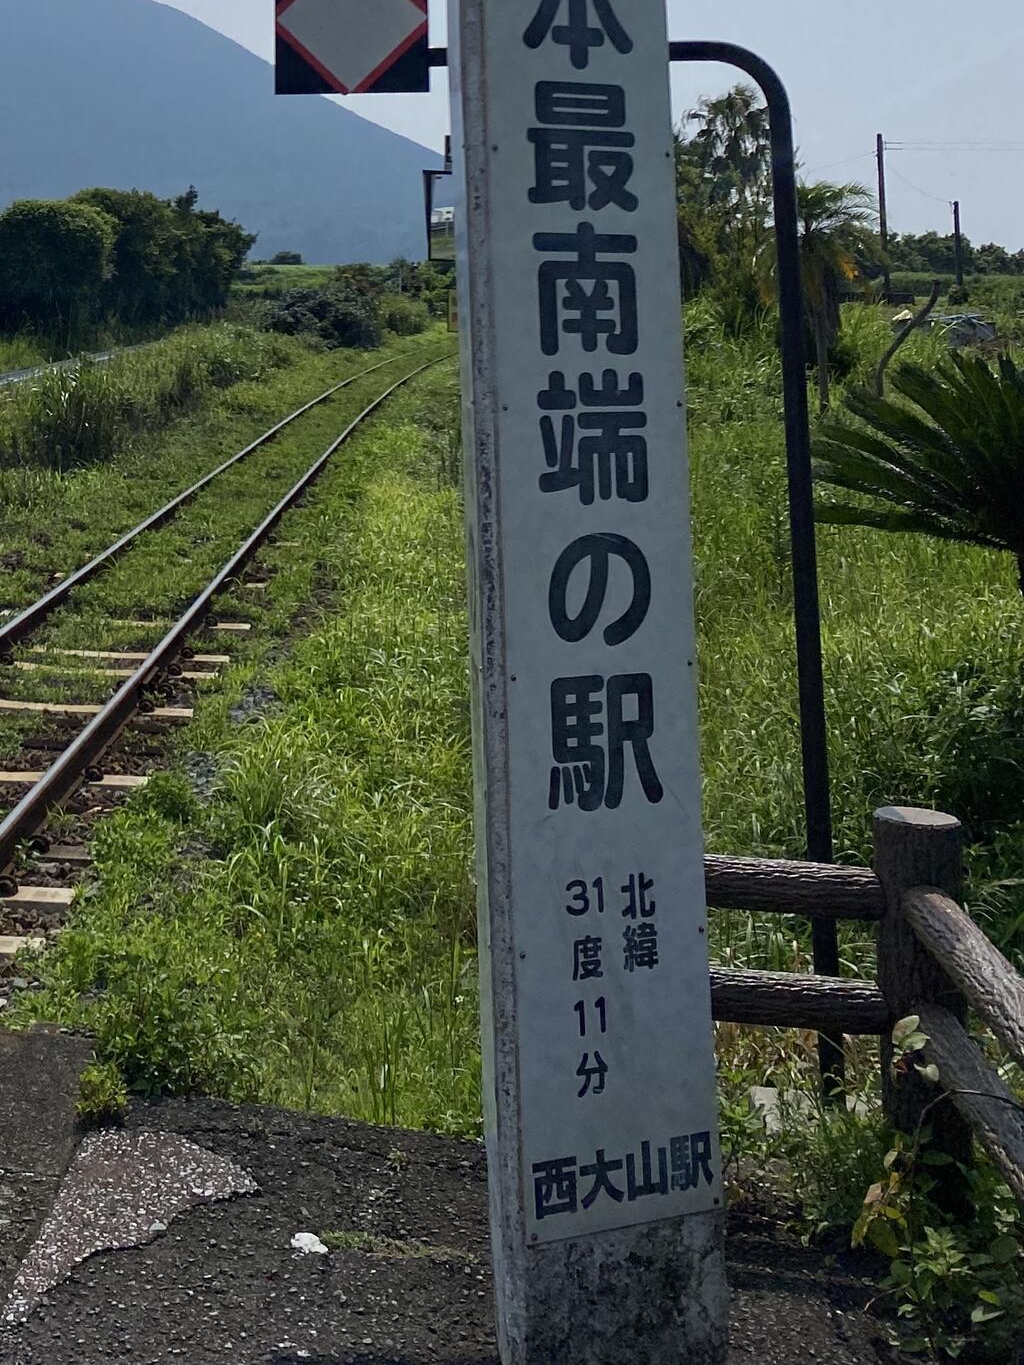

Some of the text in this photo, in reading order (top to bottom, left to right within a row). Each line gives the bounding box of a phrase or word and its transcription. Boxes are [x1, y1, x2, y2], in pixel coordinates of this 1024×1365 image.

[620, 871, 660, 973] 北緯
[531, 1130, 715, 1220] 西大山駅
